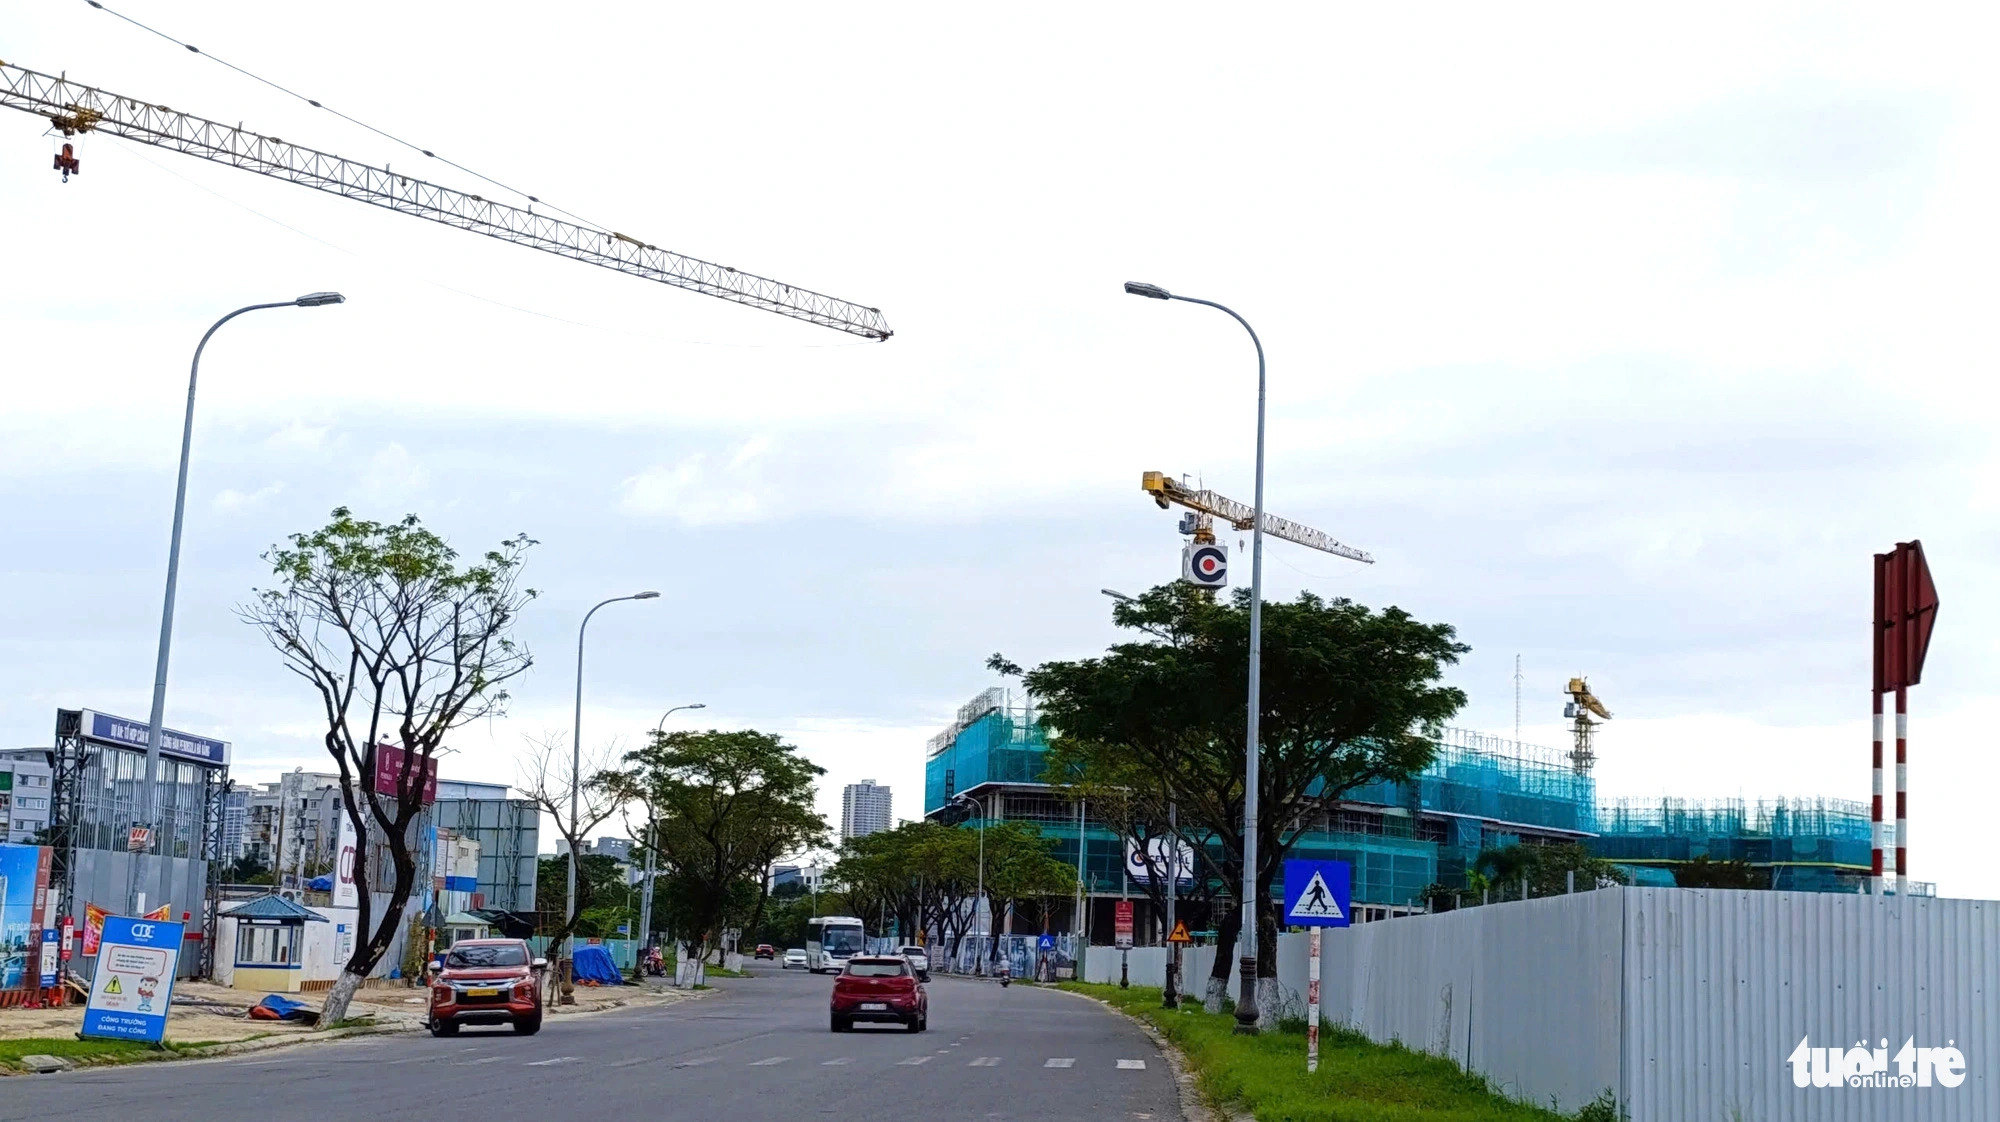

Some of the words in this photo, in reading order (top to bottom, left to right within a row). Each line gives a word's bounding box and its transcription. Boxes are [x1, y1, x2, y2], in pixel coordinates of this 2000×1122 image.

[101, 1015, 119, 1024] CÔNG
[120, 1017, 147, 1026] TRƯỜNG
[97, 1024, 116, 1032] ĐANG
[117, 1025, 128, 1033] THI
[128, 1024, 147, 1035] CÔNG
